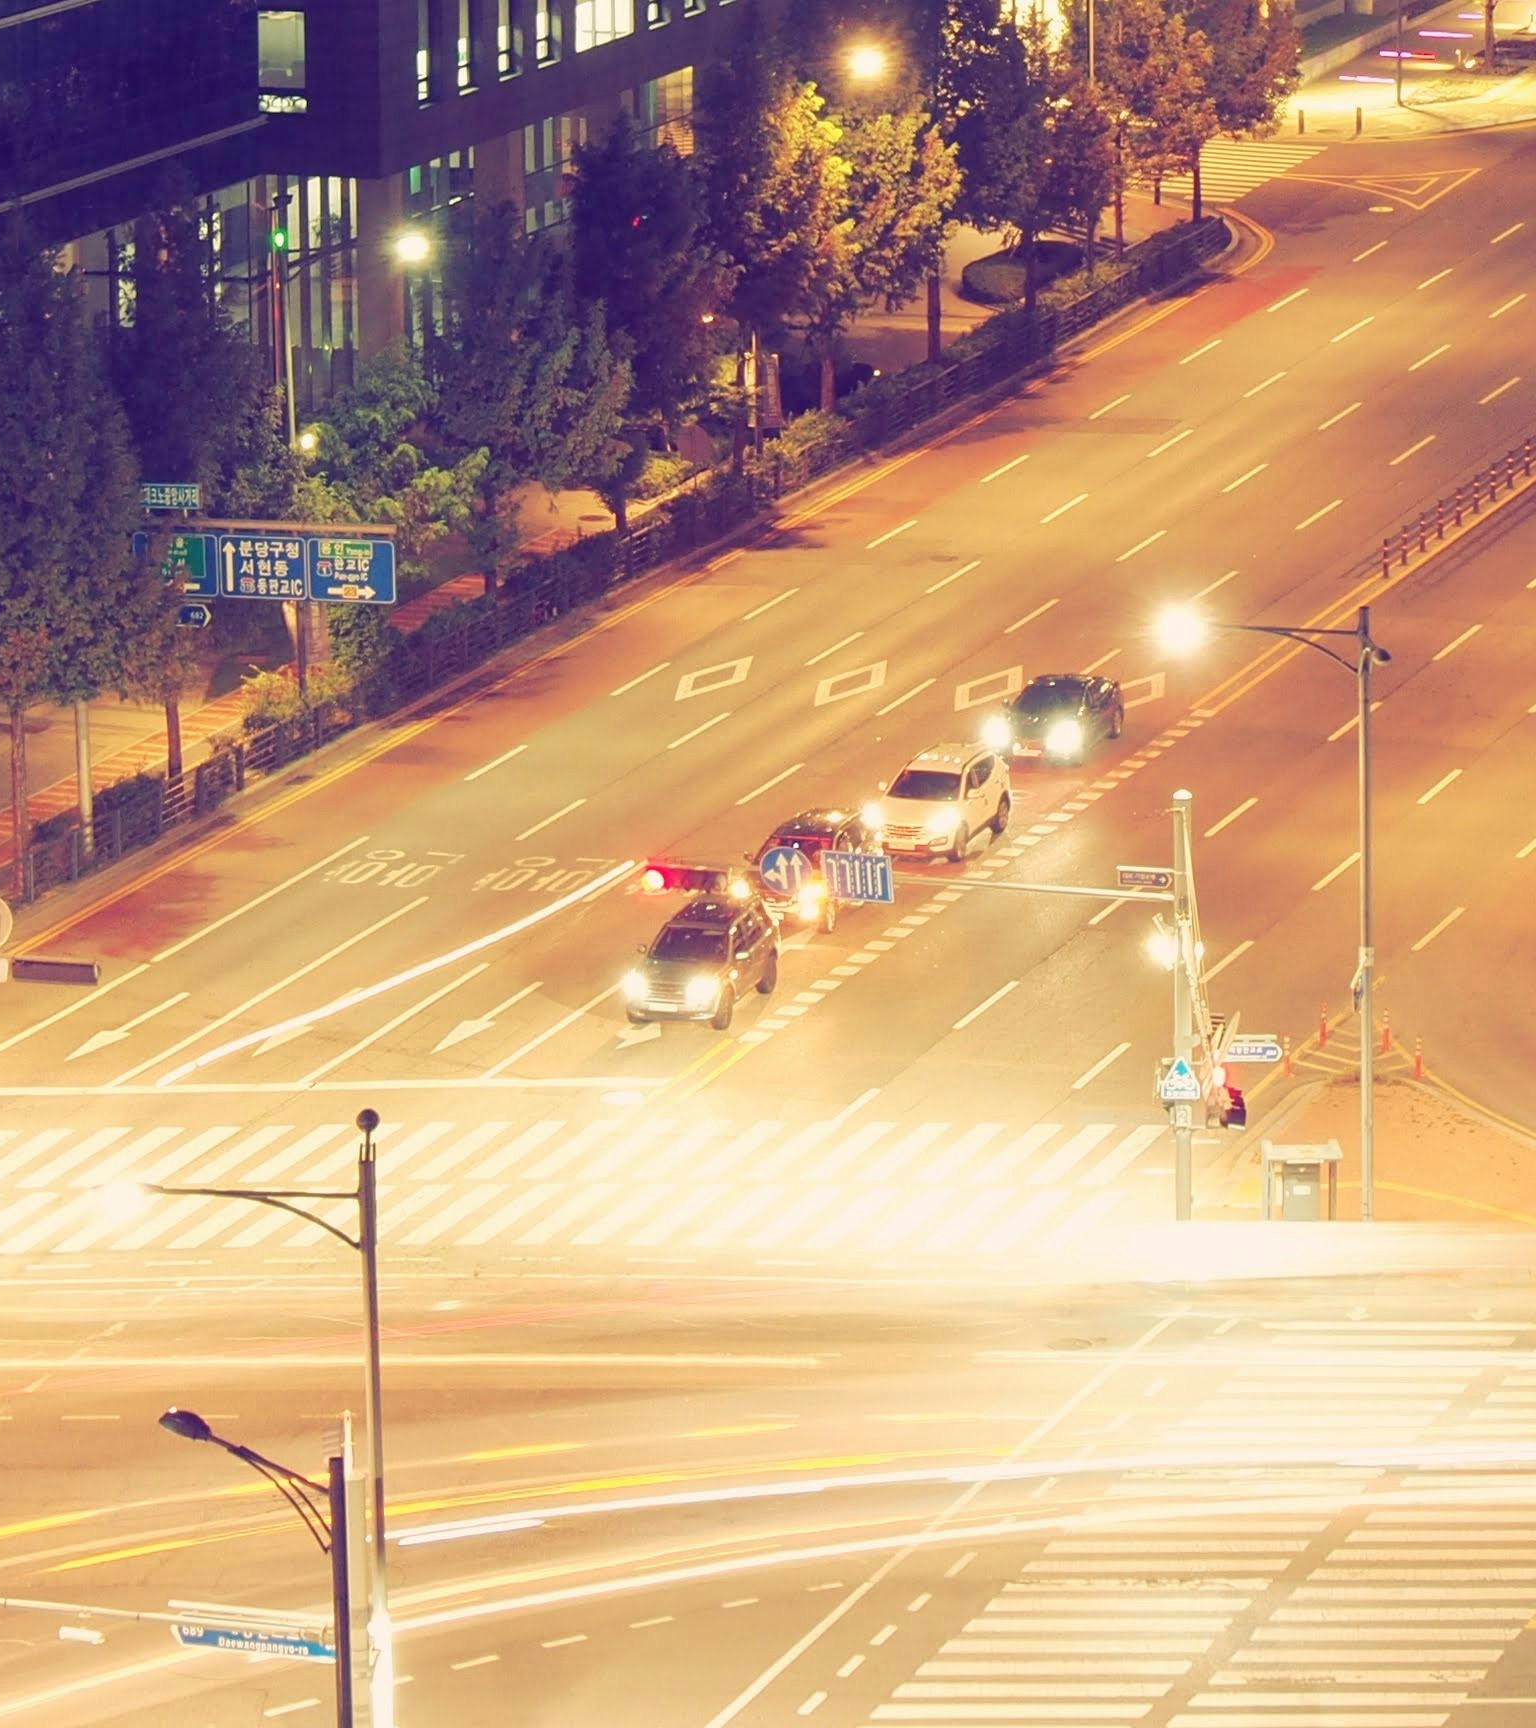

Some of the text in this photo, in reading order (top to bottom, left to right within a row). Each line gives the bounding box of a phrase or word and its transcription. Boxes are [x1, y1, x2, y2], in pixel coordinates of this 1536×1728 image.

[239, 540, 300, 559] 분당구청
[322, 542, 344, 555] 용인
[239, 559, 289, 577] 서현동
[257, 578, 303, 596] 동판교IC
